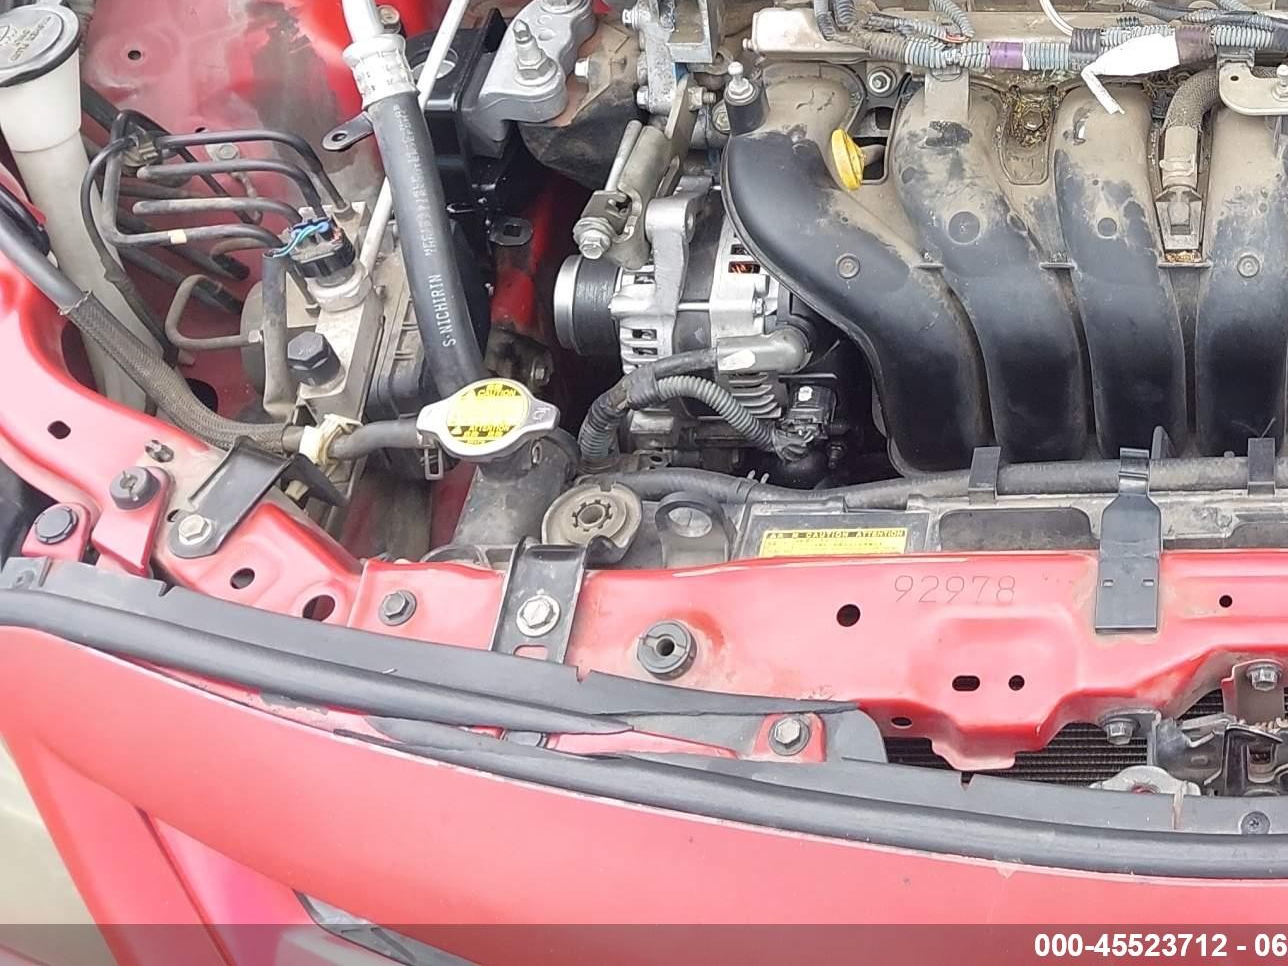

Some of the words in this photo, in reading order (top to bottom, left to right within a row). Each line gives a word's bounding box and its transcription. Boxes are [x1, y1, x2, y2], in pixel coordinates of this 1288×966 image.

[477, 389, 517, 397] CAUTION
[806, 531, 848, 539] CAUTION
[855, 530, 903, 538] ATTENTION
[893, 575, 1017, 604] 92978
